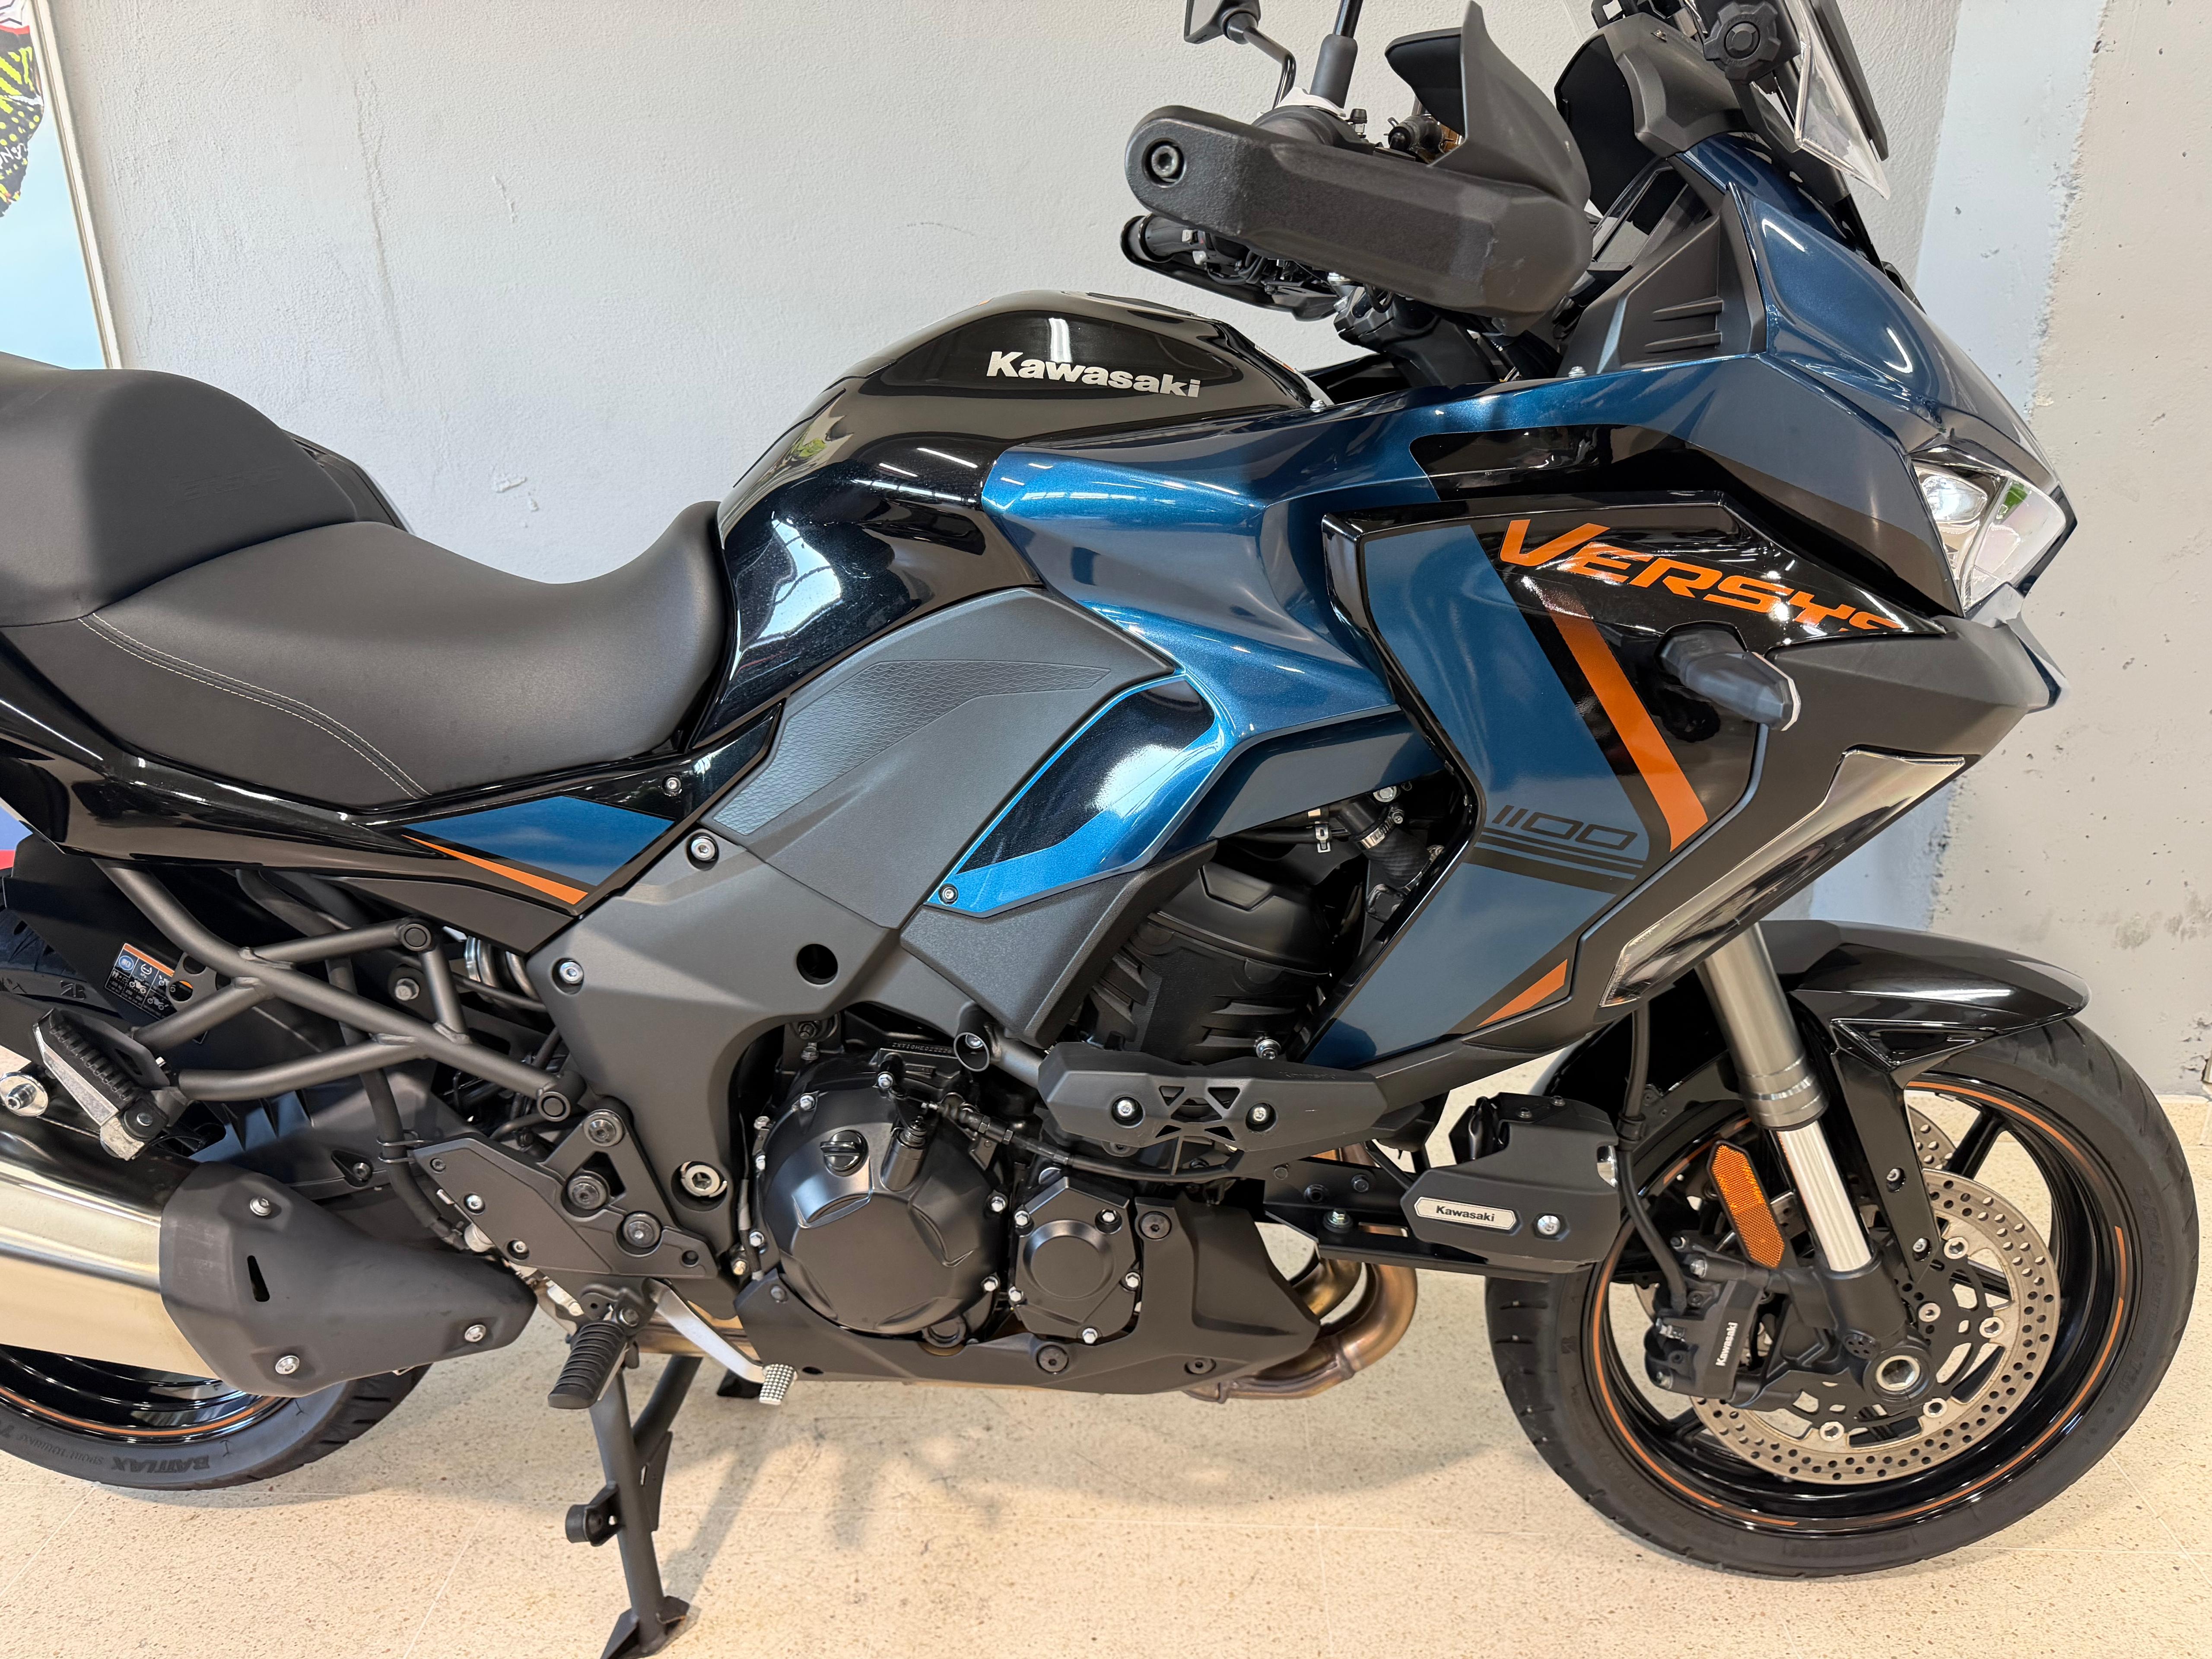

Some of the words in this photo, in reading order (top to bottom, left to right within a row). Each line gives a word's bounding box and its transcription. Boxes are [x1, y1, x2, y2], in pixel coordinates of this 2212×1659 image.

[987, 351, 1201, 397] Kawasaki
[1491, 804, 1638, 851] 1100
[1436, 1205, 1495, 1222] Kawasaki
[1716, 1322, 1738, 1366] Kawasaki
[111, 1455, 210, 1474] BATTLAX
